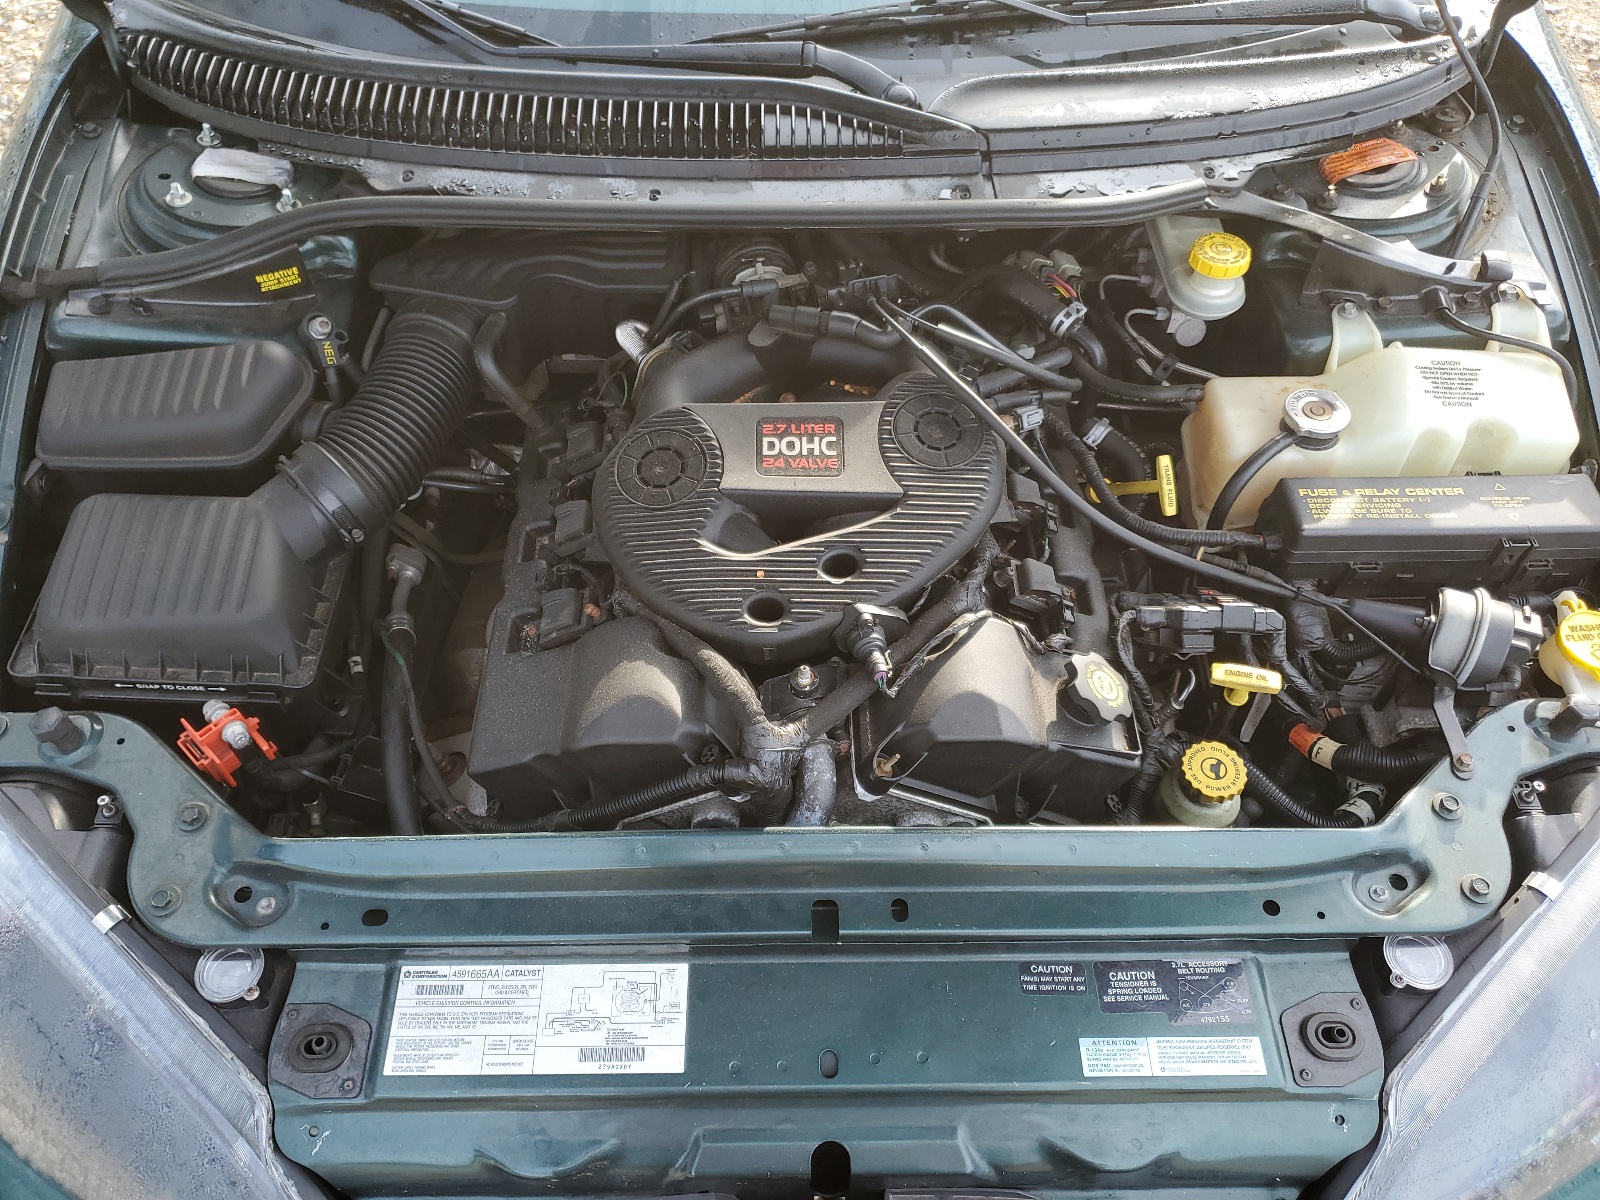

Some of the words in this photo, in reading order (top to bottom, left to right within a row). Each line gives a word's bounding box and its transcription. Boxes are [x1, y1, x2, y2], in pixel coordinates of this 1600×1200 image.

[255, 266, 299, 284] NEGATIVE
[323, 341, 337, 365] NEG
[762, 424, 787, 434] 2.7
[790, 423, 836, 434] LITER
[762, 436, 837, 456] DOHC
[762, 458, 785, 468] 24
[788, 458, 839, 469] VALVE
[1163, 464, 1172, 486] TRANS
[1298, 489, 1338, 497] FUSE
[1354, 488, 1400, 496] RELAY
[1404, 488, 1465, 496] CENTER
[1568, 624, 1600, 632] WASH
[1224, 669, 1254, 679] ENGINE
[1256, 674, 1269, 682] OIL
[1211, 746, 1230, 758] FLUID
[1187, 746, 1206, 771] APPROVED
[1229, 757, 1241, 787] STEERING
[1190, 773, 1202, 785] USE
[1205, 784, 1232, 792] POWER
[452, 969, 500, 979] 4591665AA
[504, 969, 541, 977] CATALYST
[1031, 965, 1073, 974] CAUTION
[1109, 971, 1155, 981] CAUTION
